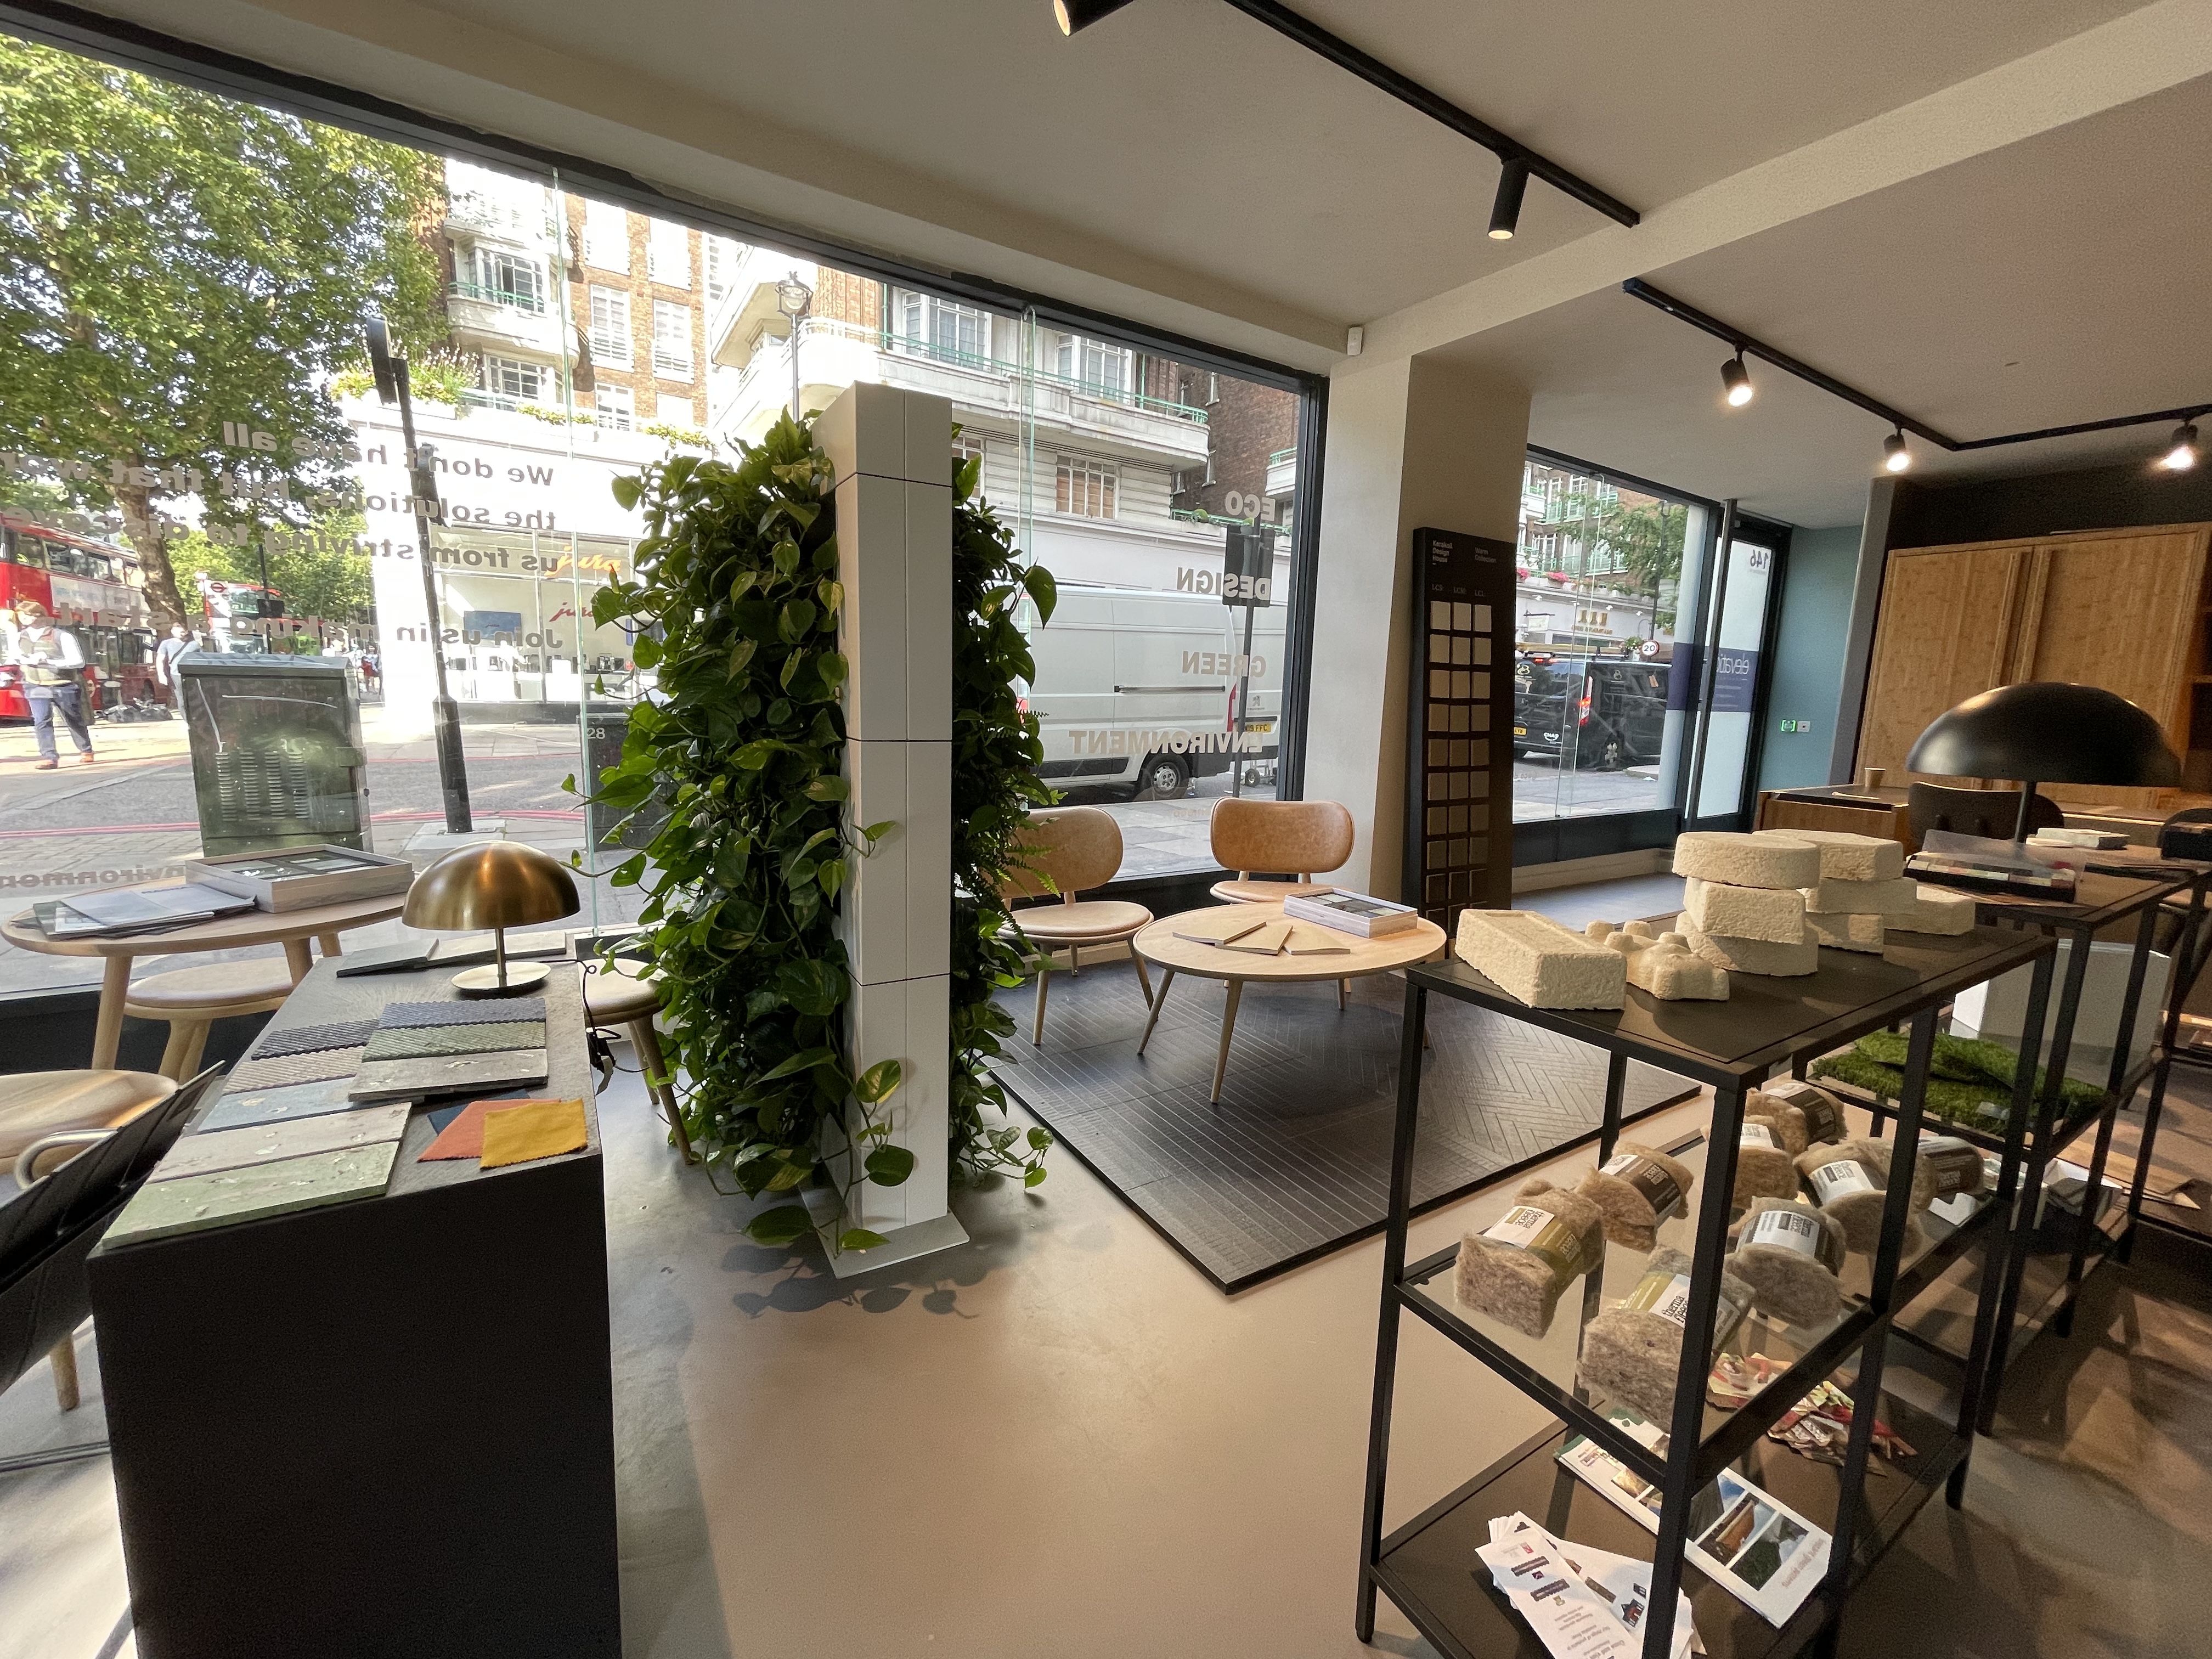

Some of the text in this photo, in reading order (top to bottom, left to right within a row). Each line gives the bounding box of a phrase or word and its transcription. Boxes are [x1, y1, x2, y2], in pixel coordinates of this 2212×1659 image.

[544, 545, 622, 578] jura
[587, 727, 606, 740] 28
[1661, 1294, 1686, 1317] therma
